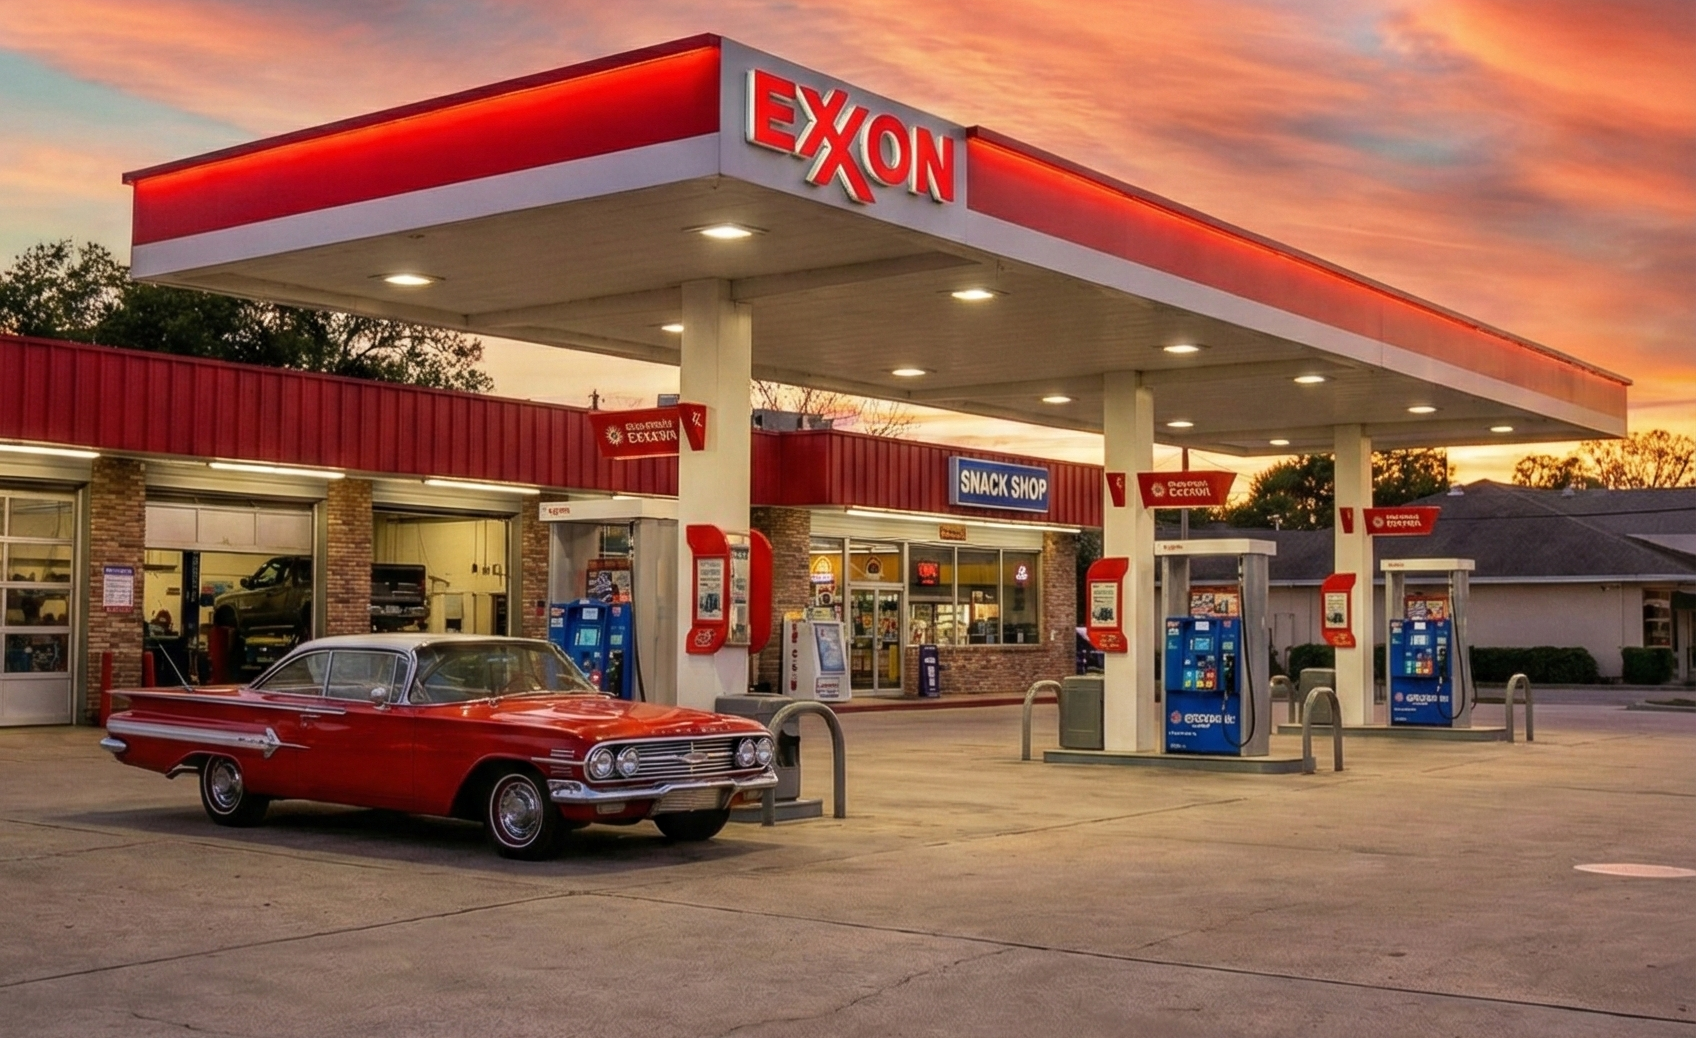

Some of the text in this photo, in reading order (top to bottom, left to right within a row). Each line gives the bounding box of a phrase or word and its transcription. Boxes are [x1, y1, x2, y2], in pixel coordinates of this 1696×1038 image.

[746, 69, 954, 203] EXXON
[961, 470, 1047, 500] SNACK SHOP
